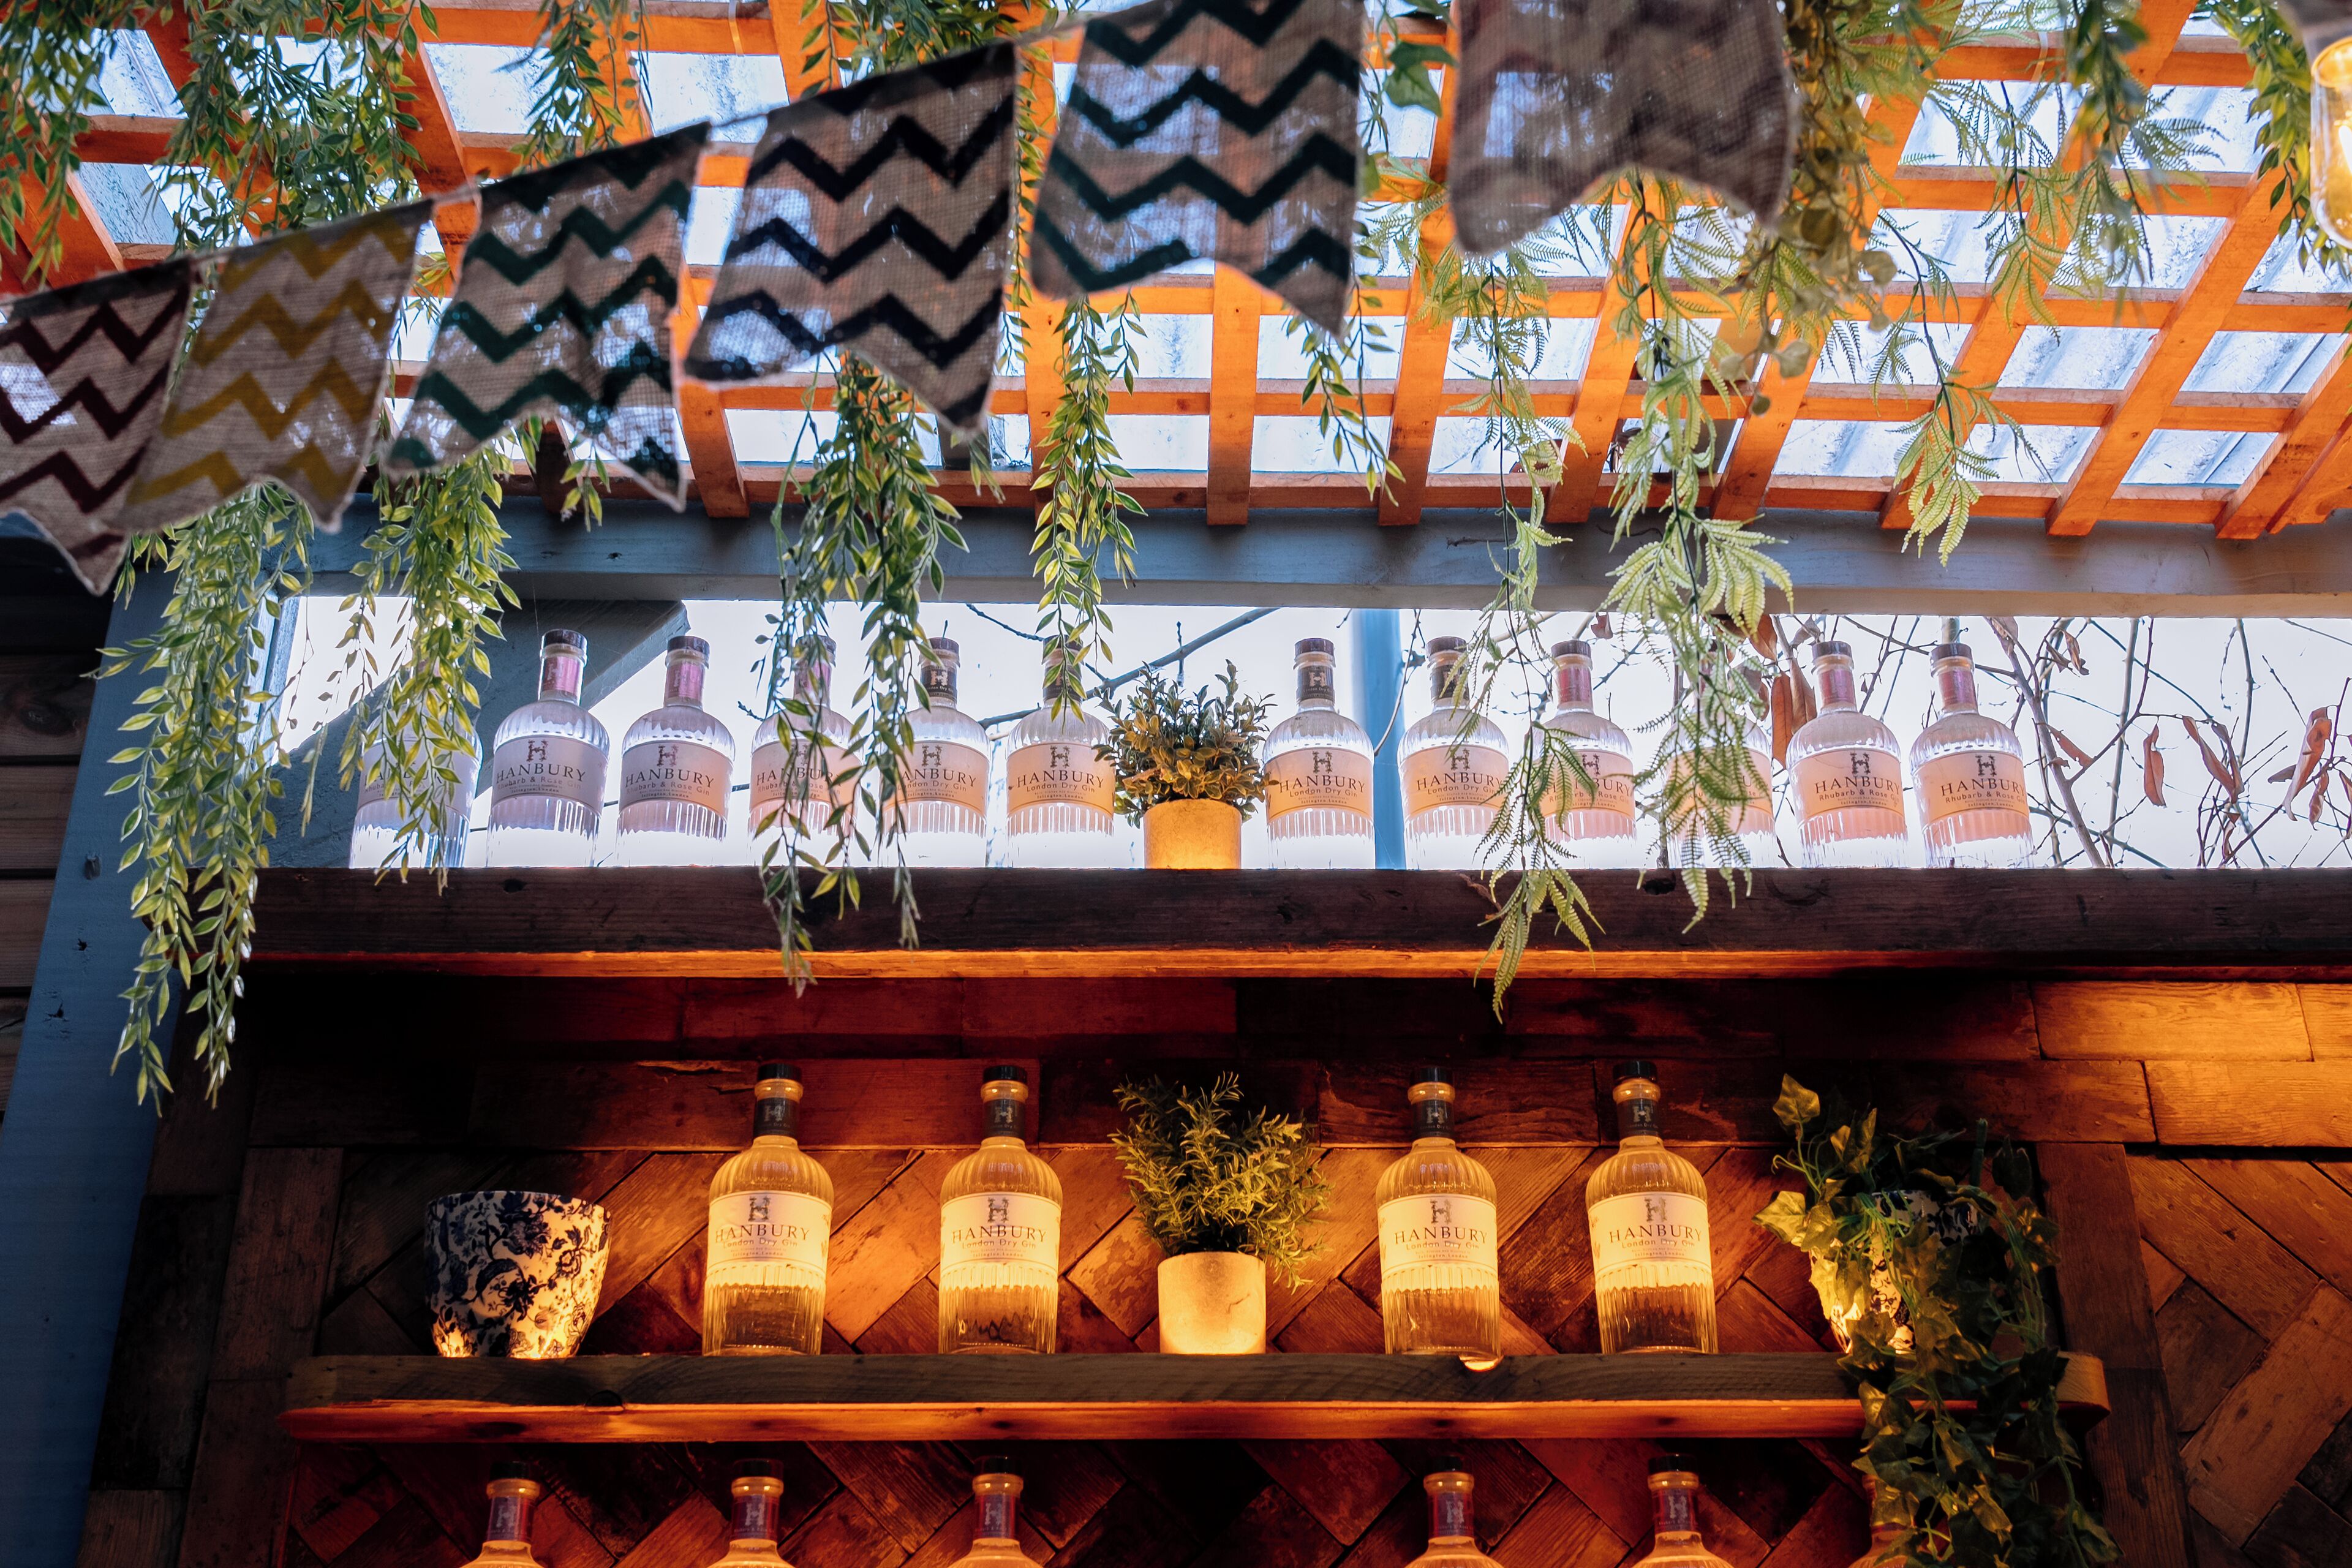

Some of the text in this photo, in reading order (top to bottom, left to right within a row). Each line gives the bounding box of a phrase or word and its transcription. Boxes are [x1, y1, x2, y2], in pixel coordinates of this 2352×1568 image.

[1309, 671, 1327, 687] H
[526, 739, 548, 762] H
[657, 744, 679, 767] H
[921, 744, 943, 767] H
[1050, 745, 1071, 768] H
[1312, 750, 1333, 774] H
[1850, 751, 1871, 776] H
[1975, 754, 1997, 777] H
[496, 763, 586, 784] HANBURY
[497, 776, 526, 790] Rhubarb
[540, 776, 563, 785] Rose
[567, 780, 582, 790] Gin
[625, 768, 714, 788] HANBURY
[901, 767, 977, 788] ANBURY
[1017, 769, 1104, 788] HANBURY
[627, 782, 656, 794] Rhubarb
[671, 782, 693, 790] Rose
[696, 788, 710, 796] Gin
[897, 780, 929, 791] Lndon
[932, 780, 949, 789] Dry
[953, 783, 967, 792] Gin
[1027, 782, 1057, 792] London
[1061, 782, 1078, 791] Dry
[1082, 785, 1095, 793] Gin
[1280, 774, 1365, 793] HANBURY
[1290, 788, 1321, 797] London
[1325, 787, 1341, 796] Dry
[1428, 785, 1459, 795] London
[1463, 784, 1479, 793] Dry
[1483, 786, 1495, 794] Gin
[1815, 775, 1900, 795] HANBURY
[1941, 778, 2024, 797] HANBURY
[1598, 791, 1617, 800] Rose
[1819, 790, 1855, 801] Rhubarb
[1869, 790, 1888, 798] Rose
[1945, 791, 1981, 804] Rhubarb
[1996, 791, 2015, 800] Rose
[748, 1196, 771, 1221] H
[987, 1196, 1009, 1223] H
[1430, 1199, 1452, 1224] H
[1644, 1197, 1667, 1222] H
[715, 1224, 810, 1243] HANBURY
[723, 1237, 797, 1249] London Dry Gin
[952, 1225, 1046, 1244] HANBURY
[1394, 1226, 1487, 1245] HANBURY
[1610, 1224, 1702, 1243] HANBURY
[962, 1238, 1036, 1249] London Dry Gin
[1406, 1240, 1439, 1250] London
[1444, 1240, 1461, 1250] Dry
[1622, 1239, 1656, 1249] London
[1661, 1238, 1678, 1247] Dry
